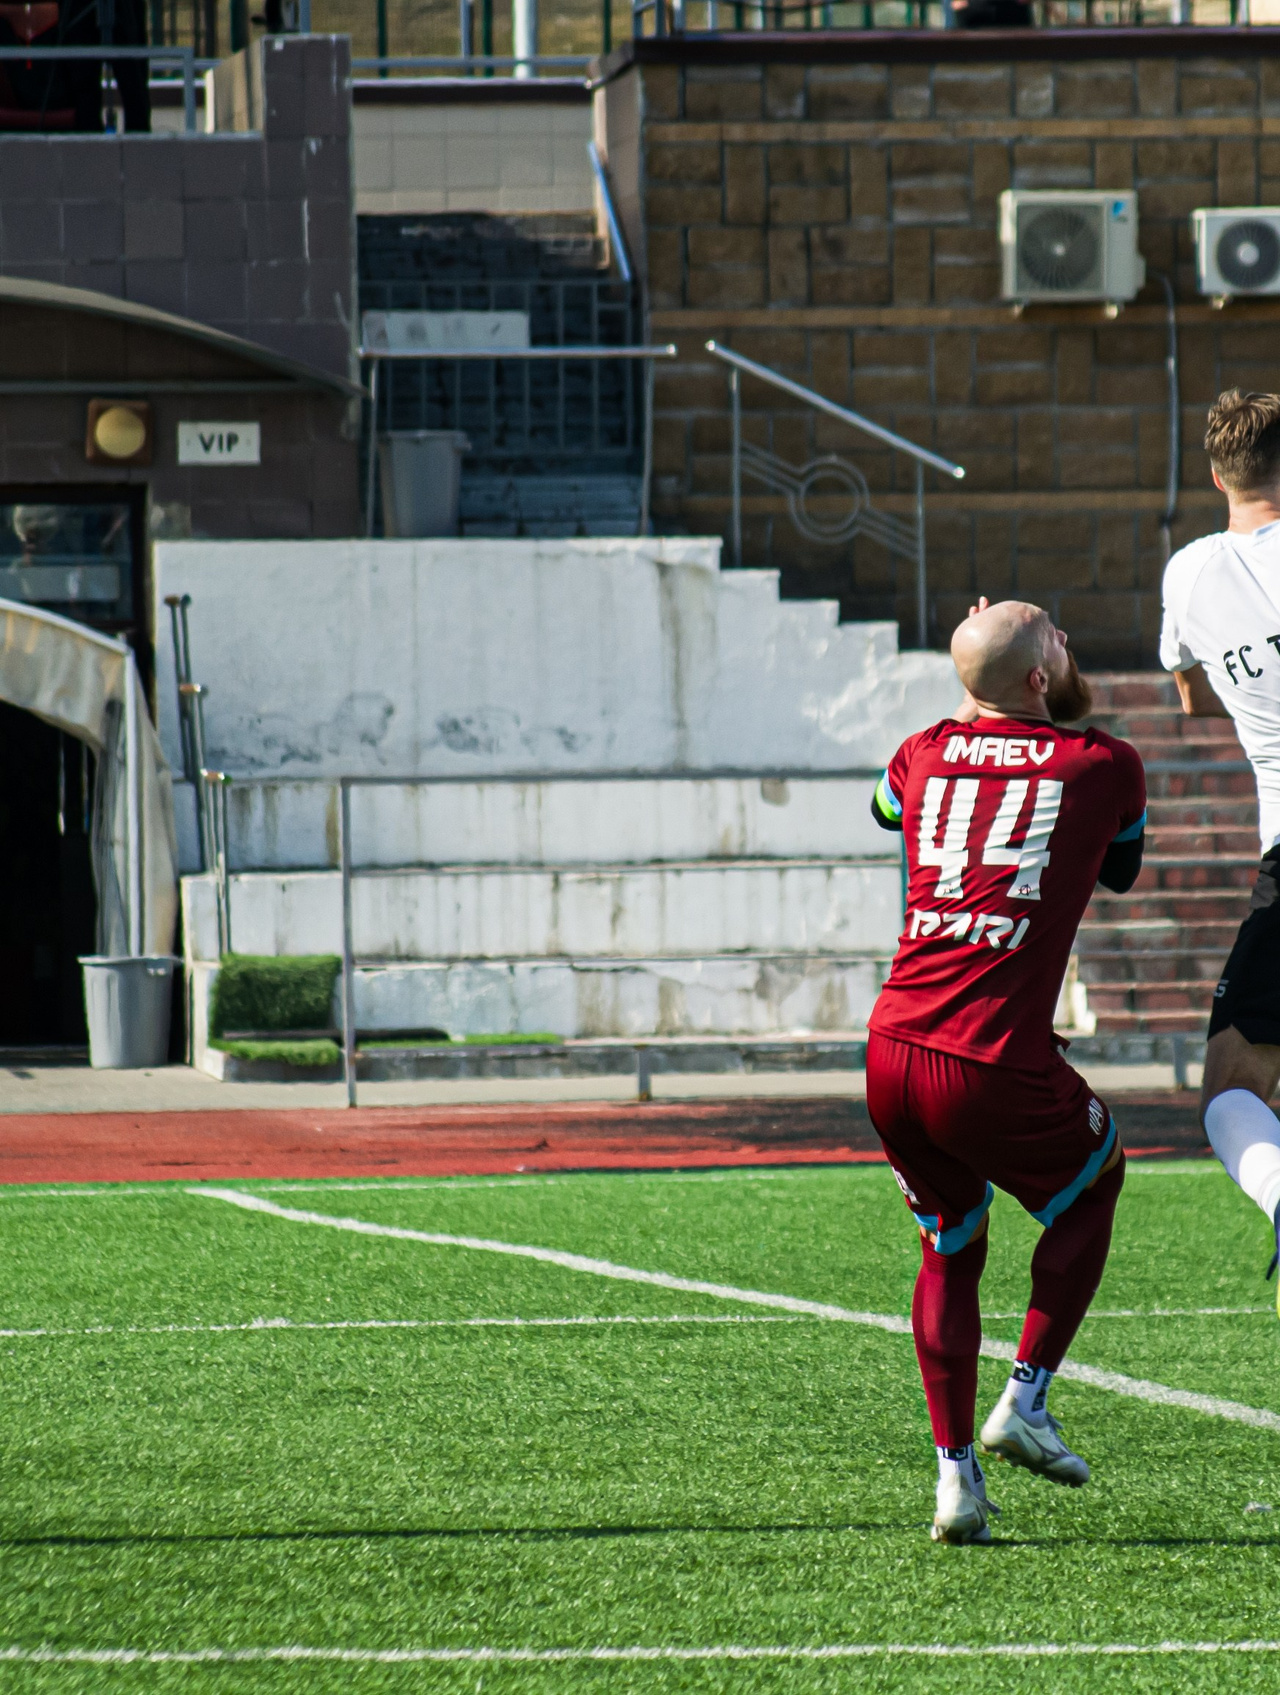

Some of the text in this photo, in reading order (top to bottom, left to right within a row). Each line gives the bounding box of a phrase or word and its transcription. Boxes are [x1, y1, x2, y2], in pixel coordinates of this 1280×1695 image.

[198, 431, 240, 454] VIP
[1223, 645, 1263, 686] FC
[943, 735, 1055, 766] IMAEV
[918, 776, 1064, 900] 44
